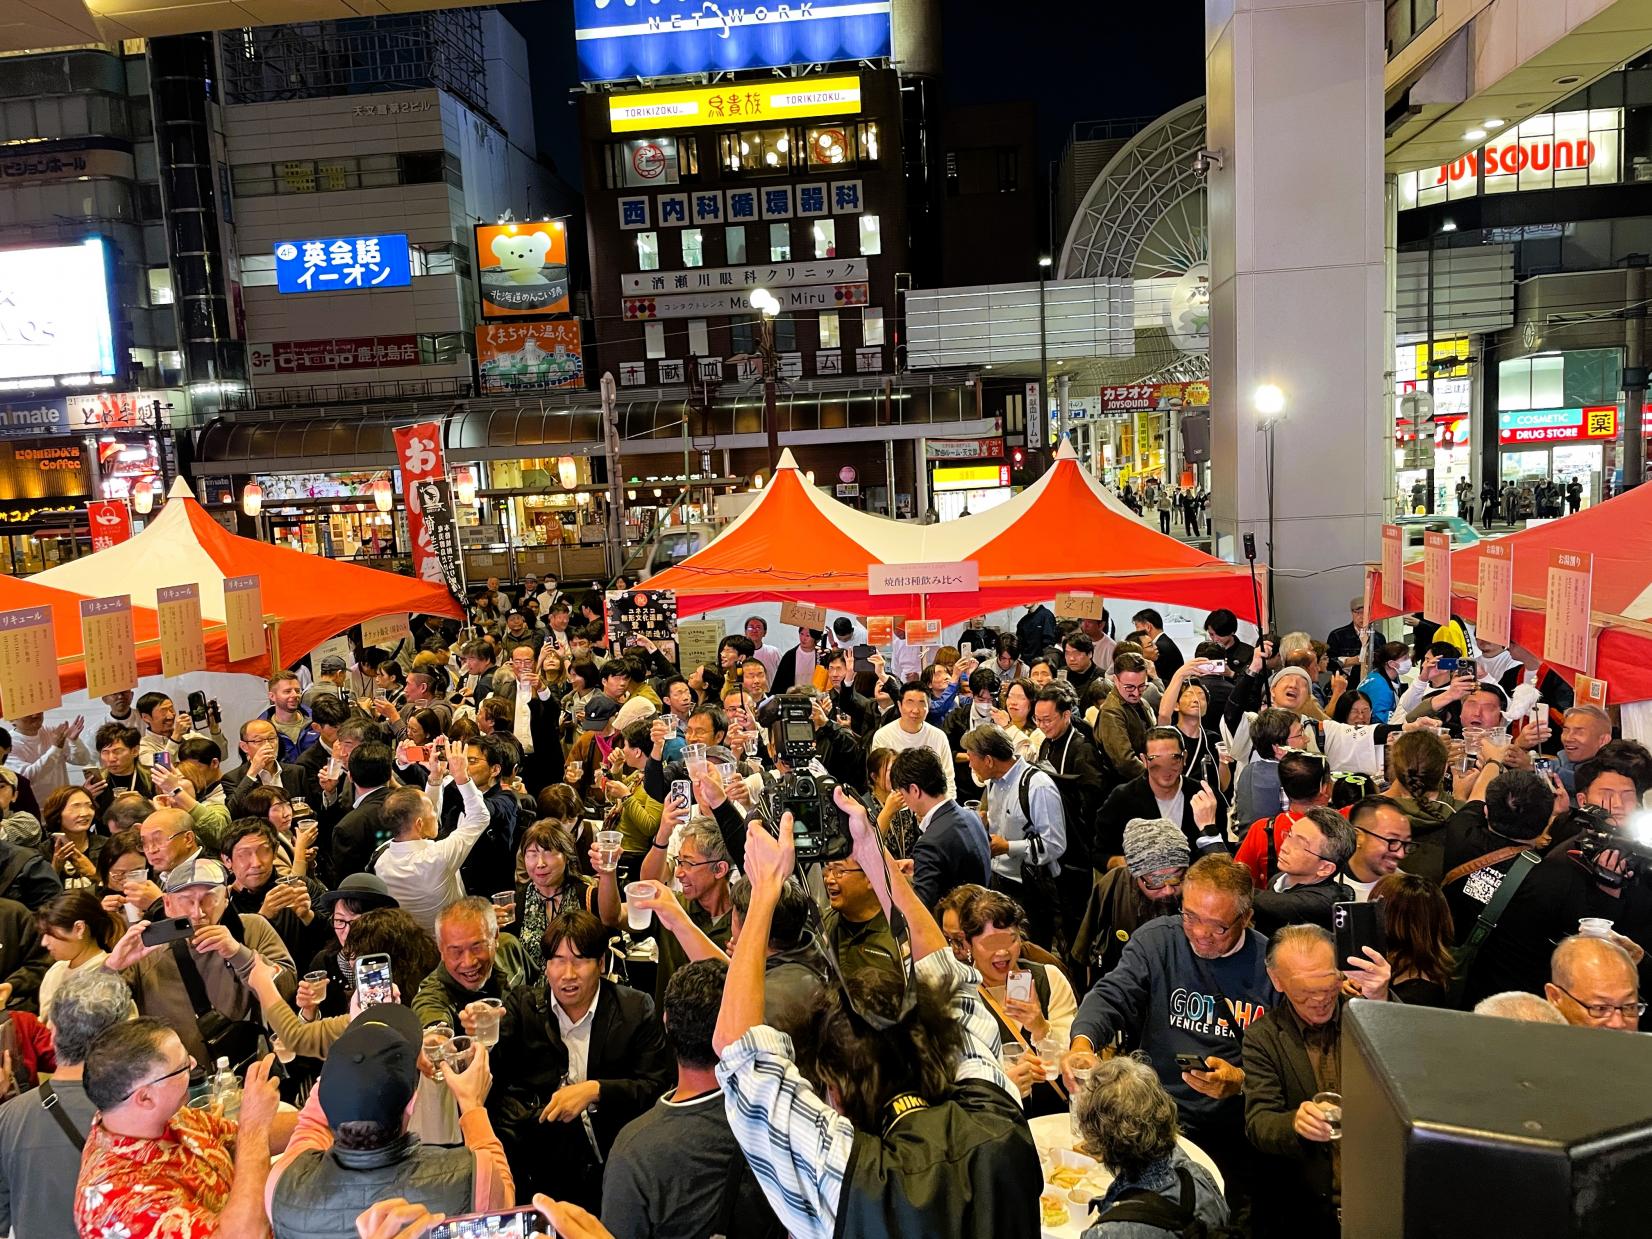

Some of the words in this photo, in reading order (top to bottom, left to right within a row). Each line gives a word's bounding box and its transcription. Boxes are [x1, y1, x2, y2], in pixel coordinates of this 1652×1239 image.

[786, 92, 841, 105] TORIKIZOKU
[624, 104, 679, 118] TORIKIZOKU
[622, 183, 860, 226] 西内科循環器科
[302, 238, 382, 268] 英会話
[297, 263, 391, 290] イーオン
[651, 262, 856, 290] 酒瀬川眼科クリニック
[490, 288, 563, 303] 北海道めんこい鍋
[791, 292, 826, 306] Miru
[486, 324, 571, 346] くまちゃん温泉
[251, 350, 272, 368] 3F
[357, 343, 416, 363] 鹿児島店
[1103, 387, 1154, 401] カラオケ
[1107, 399, 1149, 409] JOYSOUND
[1029, 398, 1039, 438] 献血ルーム
[1516, 413, 1569, 425] COSMETIC
[1590, 413, 1612, 434] 薬
[1516, 428, 1545, 440] DRUG
[1547, 427, 1579, 439] STORE
[39, 459, 82, 470] Coffee
[1558, 553, 1582, 568] お湯割り
[163, 587, 192, 599] リキュール
[88, 598, 123, 612] リキュール
[1064, 597, 1096, 613] 受付
[2, 613, 43, 625] リキュール
[1169, 1014, 1209, 1034] VENICE
